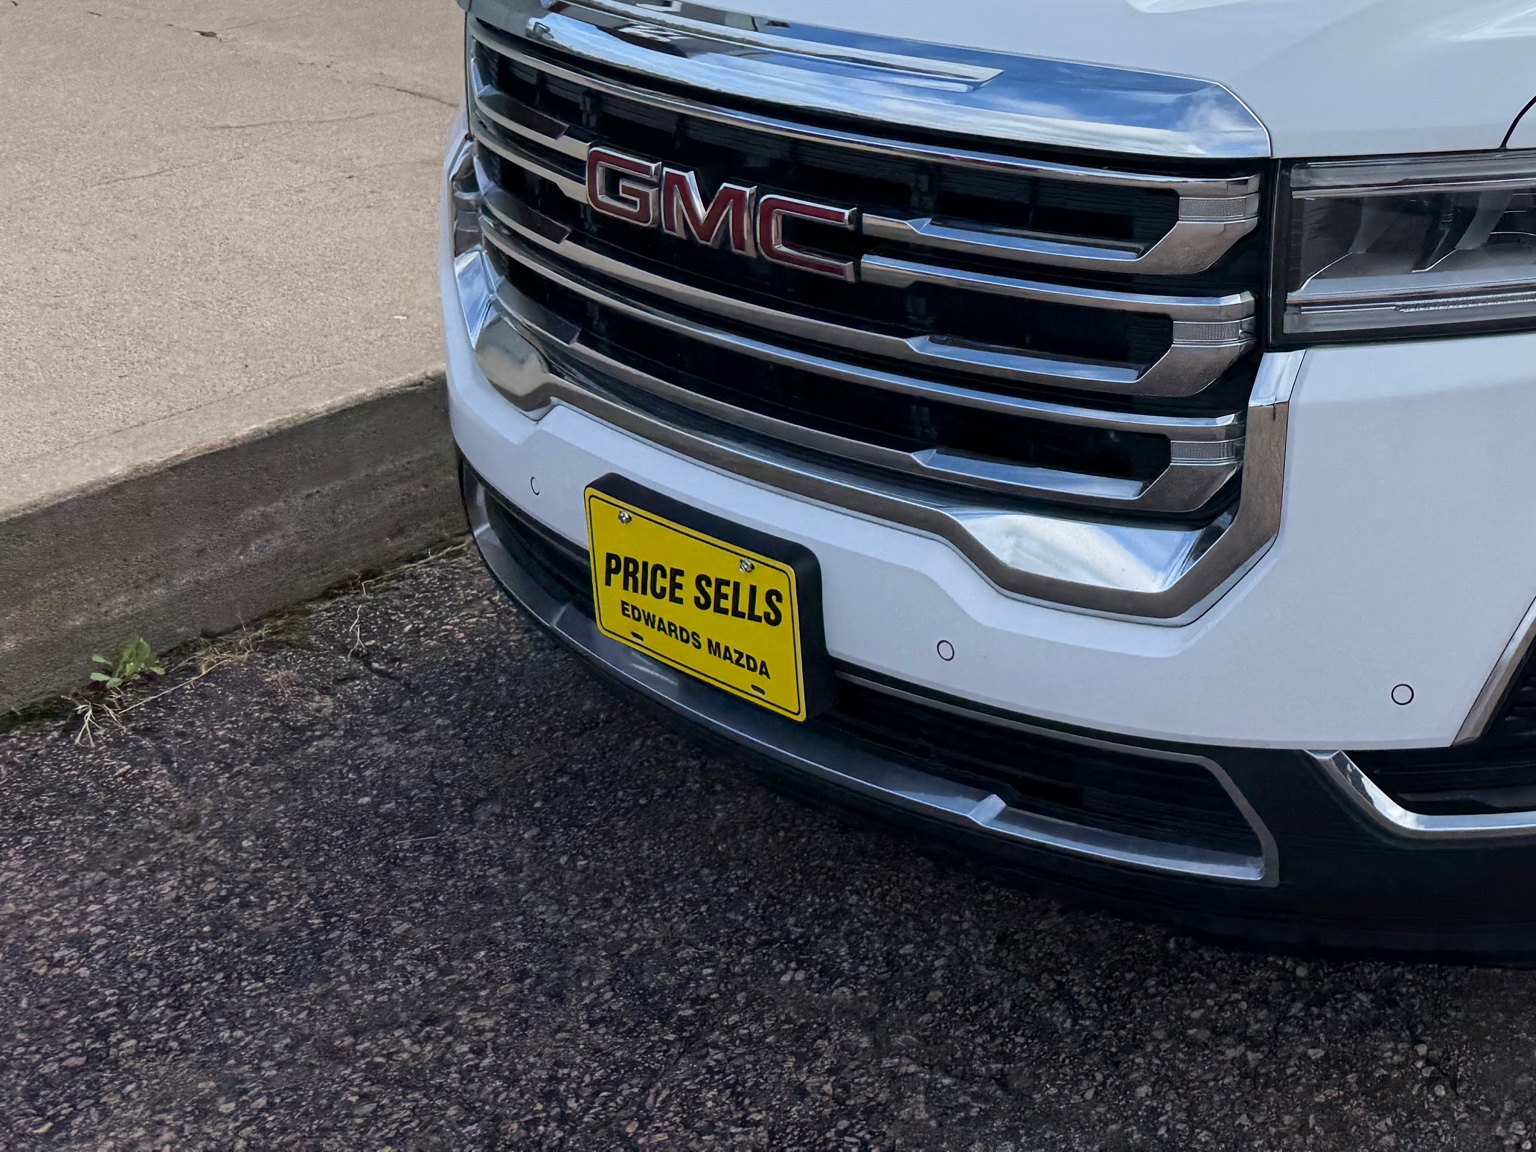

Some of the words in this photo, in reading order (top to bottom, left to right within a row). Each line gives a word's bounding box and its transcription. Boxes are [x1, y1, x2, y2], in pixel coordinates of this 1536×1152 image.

[586, 147, 857, 283] GMC
[604, 552, 685, 605] PRICE
[693, 573, 783, 627] SELLS
[620, 599, 701, 650] EDWARDS
[707, 637, 771, 680] MAZDA
